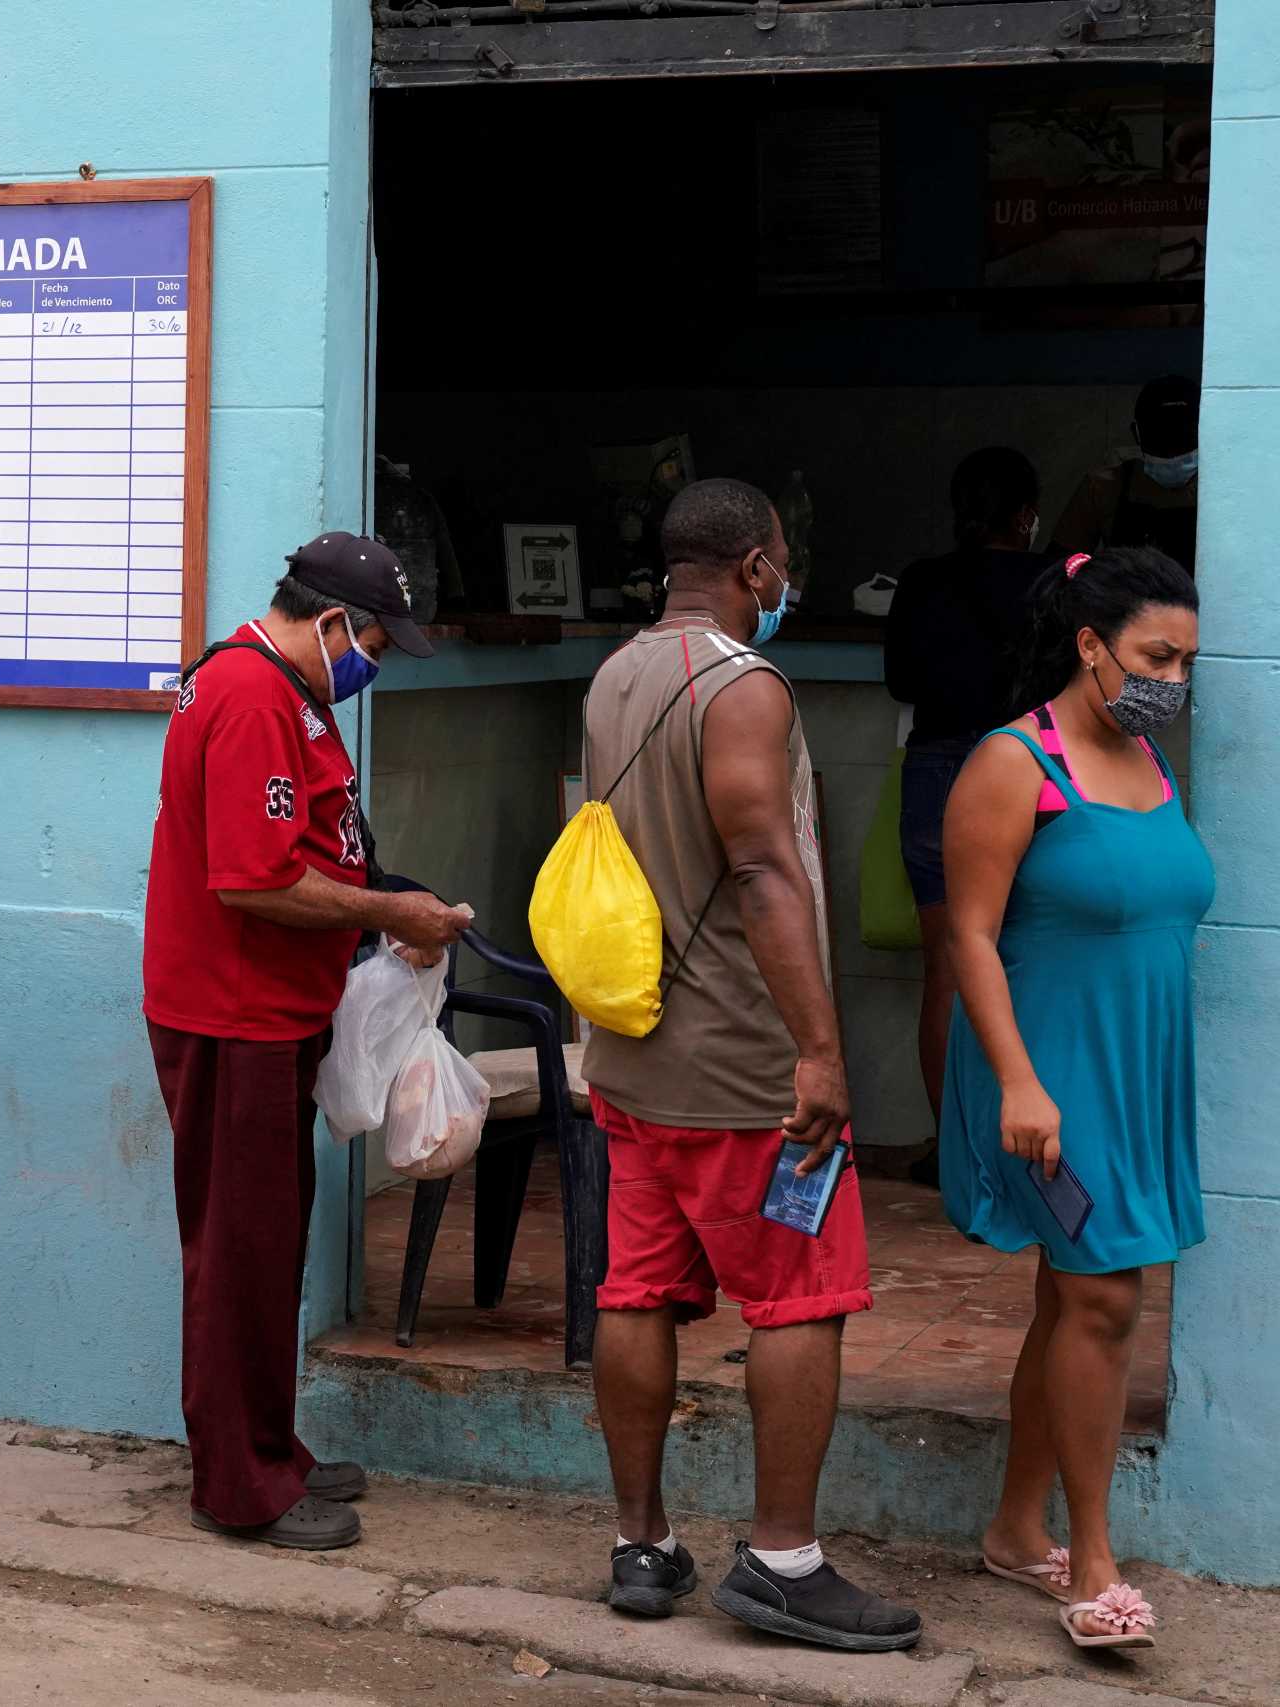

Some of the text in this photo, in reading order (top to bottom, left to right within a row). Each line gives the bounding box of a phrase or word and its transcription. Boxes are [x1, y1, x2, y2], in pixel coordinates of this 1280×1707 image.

[41, 282, 68, 293] Fecha
[157, 280, 180, 291] Dato
[41, 296, 113, 308] de Vencimiento
[157, 294, 178, 305] ORC
